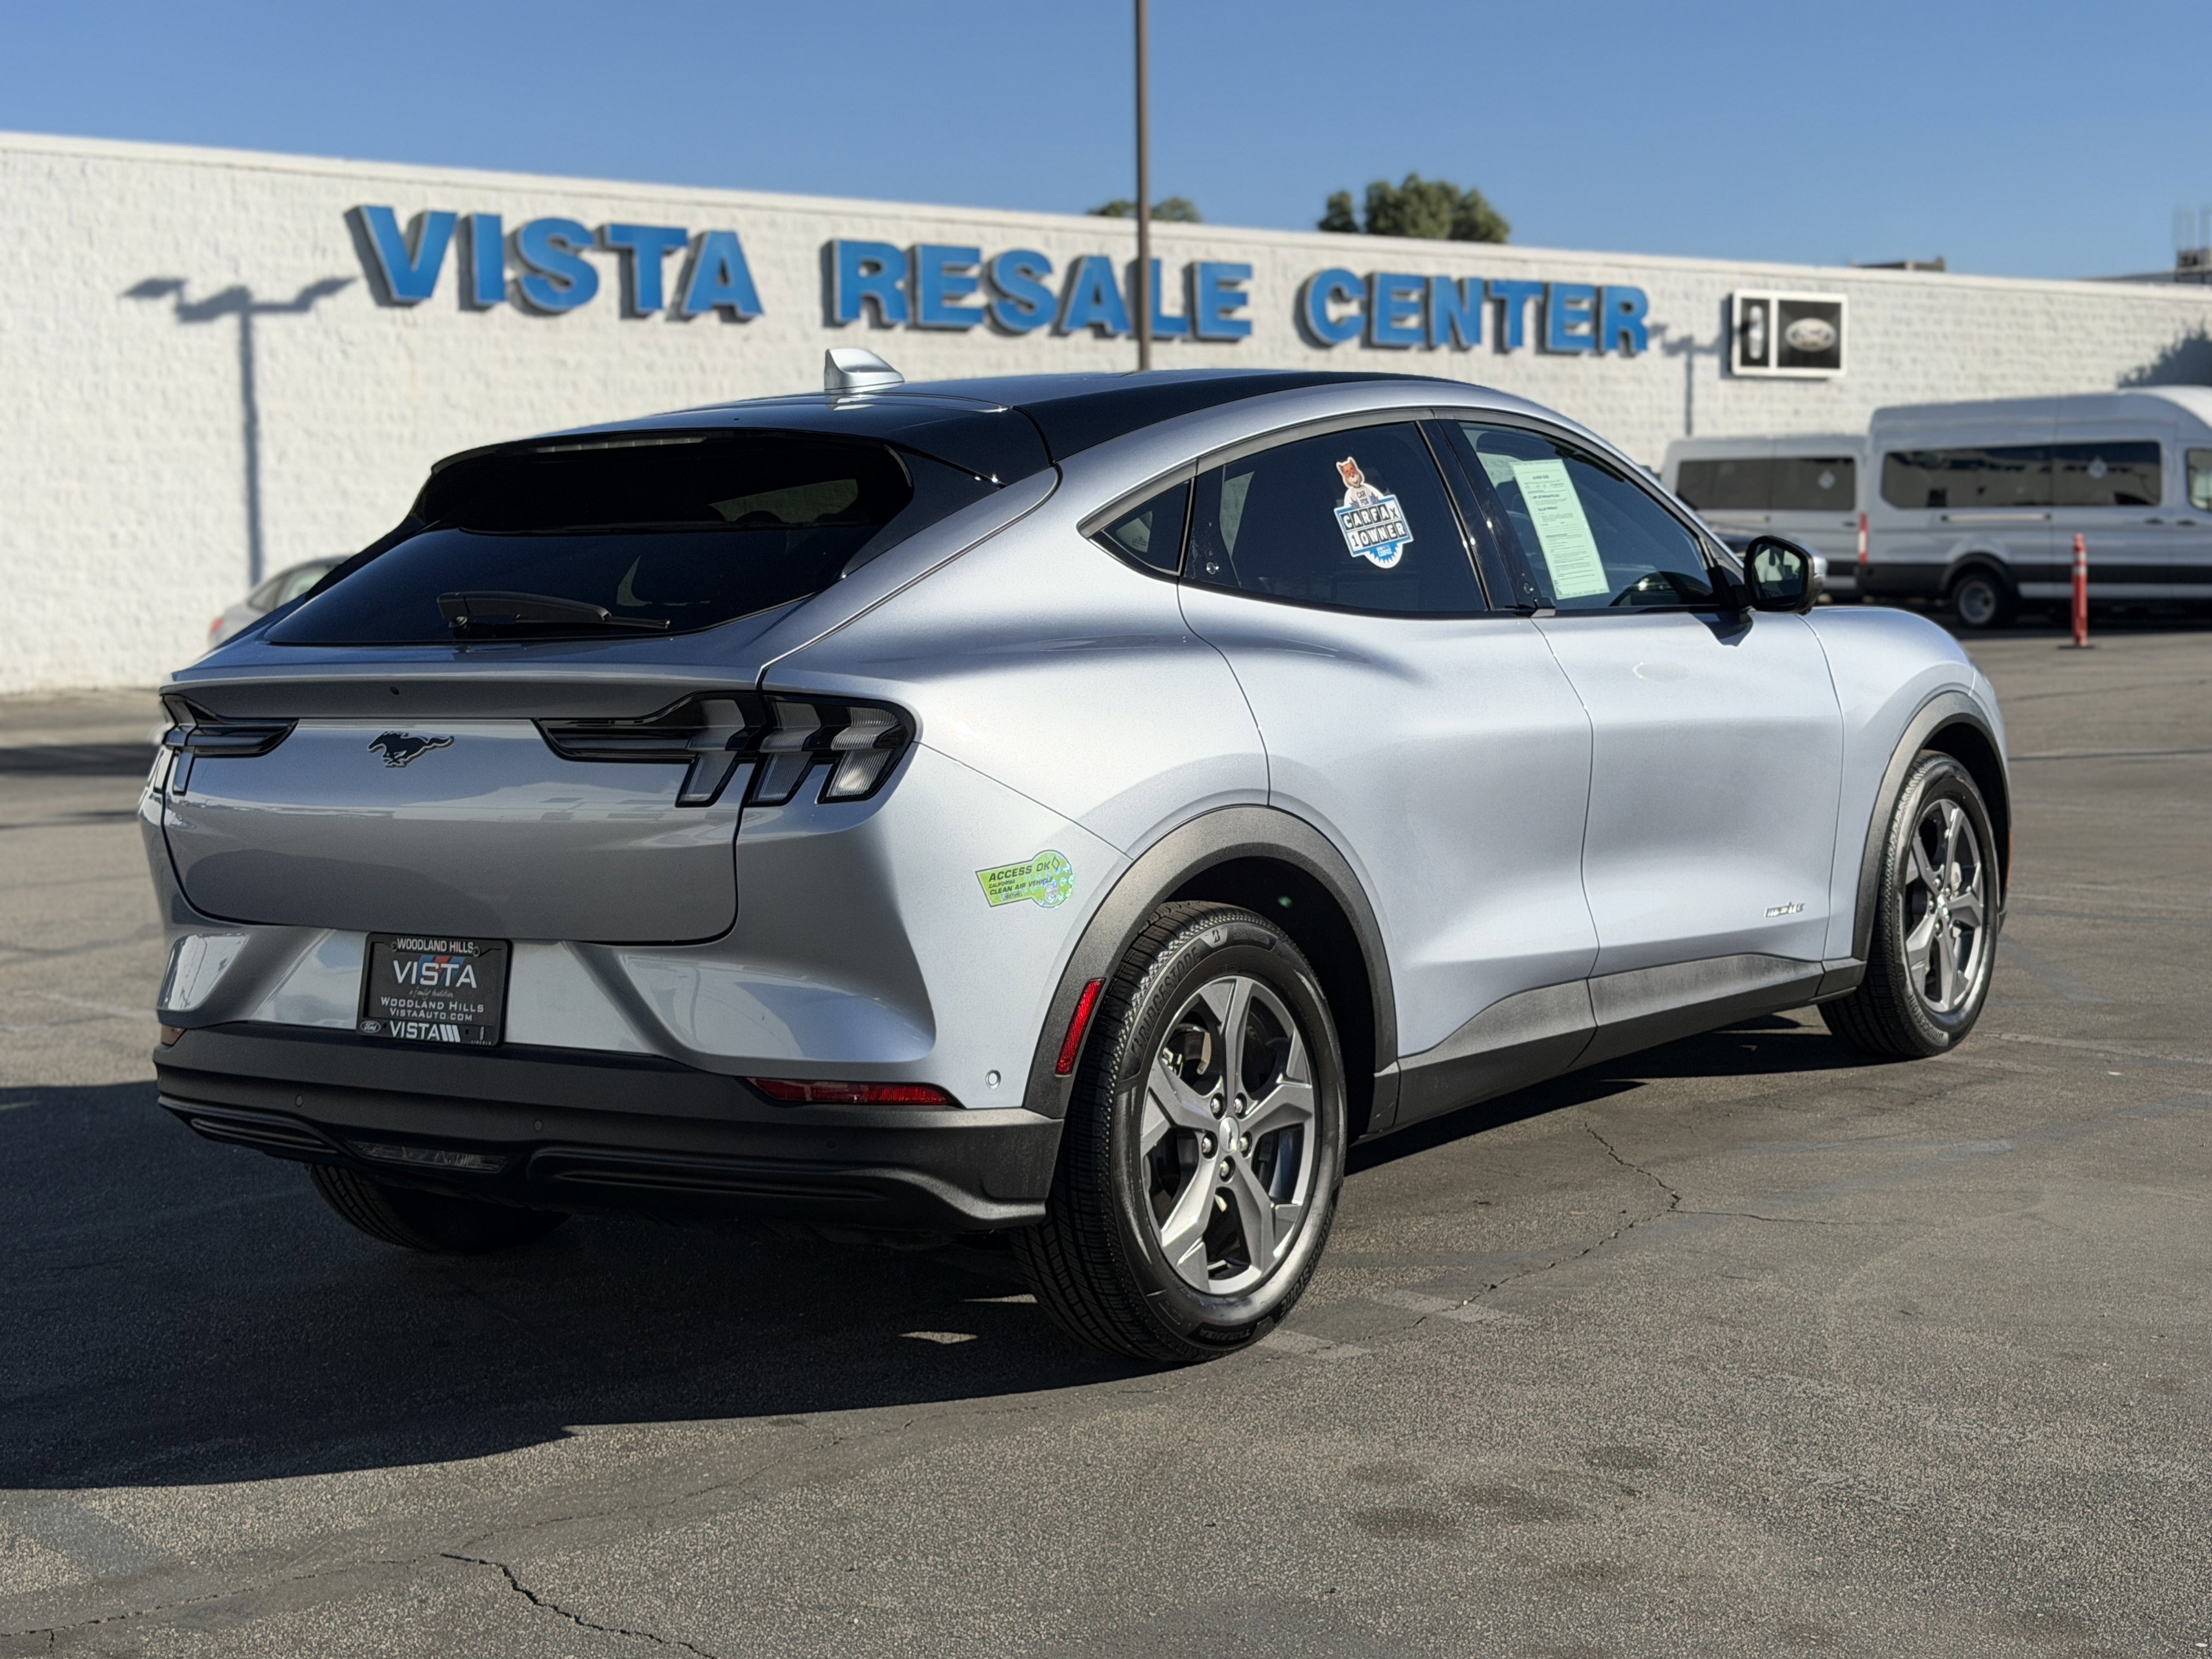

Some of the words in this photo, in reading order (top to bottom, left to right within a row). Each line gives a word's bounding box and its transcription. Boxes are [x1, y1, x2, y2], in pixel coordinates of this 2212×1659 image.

[354, 205, 764, 317] VISTA
[830, 239, 1252, 338] RESALE
[1305, 268, 1649, 354] CENTER
[1356, 490, 1367, 499] CAR
[1343, 505, 1400, 528] CARFAX
[988, 865, 1032, 882] ACCESS
[1036, 861, 1051, 872] OK
[990, 886, 1012, 895] CLEAN
[396, 938, 447, 952] WOODLAND
[449, 940, 474, 954] HILLS
[393, 960, 477, 989] VISTA
[381, 996, 444, 1011] WOODLAND
[449, 1001, 484, 1013] HILLS
[390, 1020, 441, 1041] VISTA
